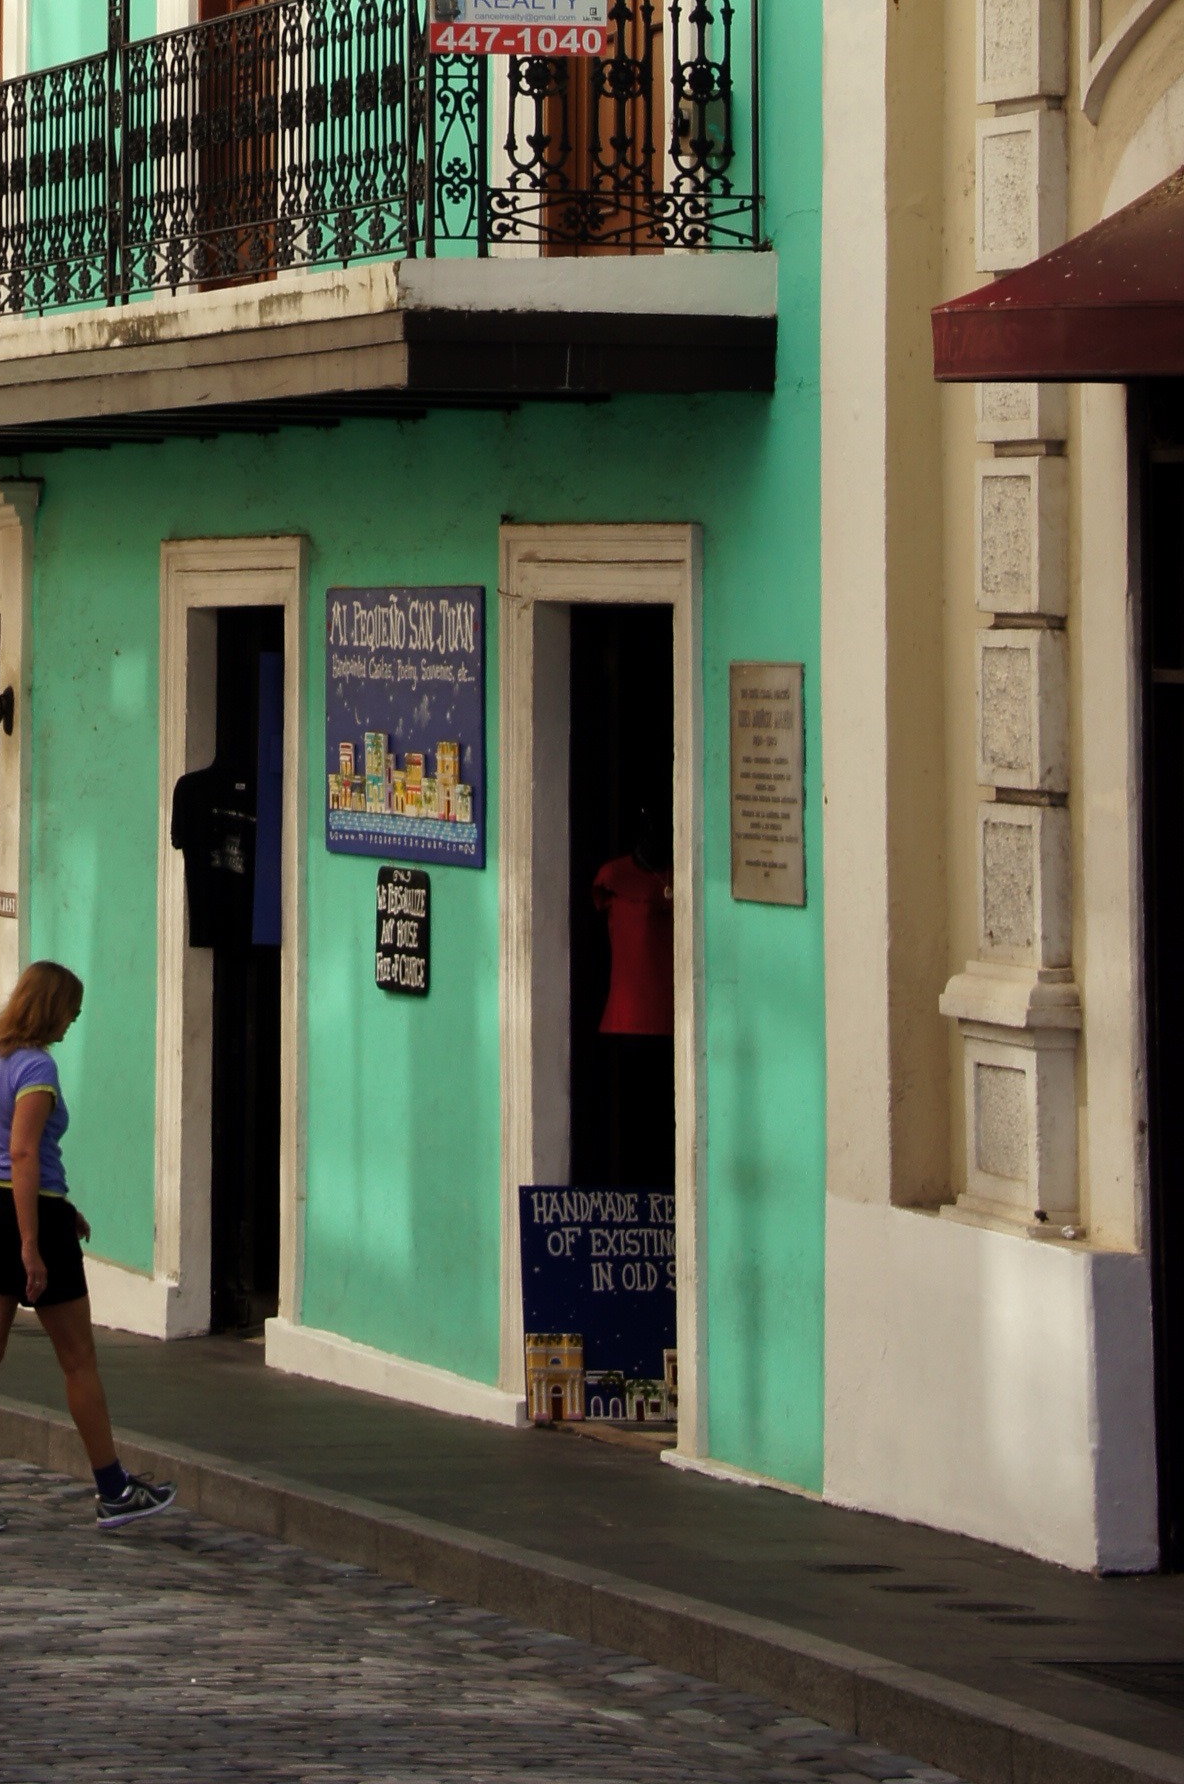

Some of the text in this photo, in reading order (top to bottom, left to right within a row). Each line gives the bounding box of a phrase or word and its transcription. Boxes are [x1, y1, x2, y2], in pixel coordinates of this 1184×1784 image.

[474, 13, 576, 22] cancelrealty@gmail.com
[436, 27, 602, 53] 447-1040
[330, 594, 476, 654] MI PEQUEÑO SAN JUAN
[396, 919, 418, 948] HOUSE
[376, 952, 391, 982] FREE
[399, 954, 426, 988] CHARGE
[531, 1191, 638, 1224] HANDMADE
[547, 1227, 581, 1256] OF
[591, 1262, 614, 1292] IN
[622, 1262, 658, 1291] OLD
